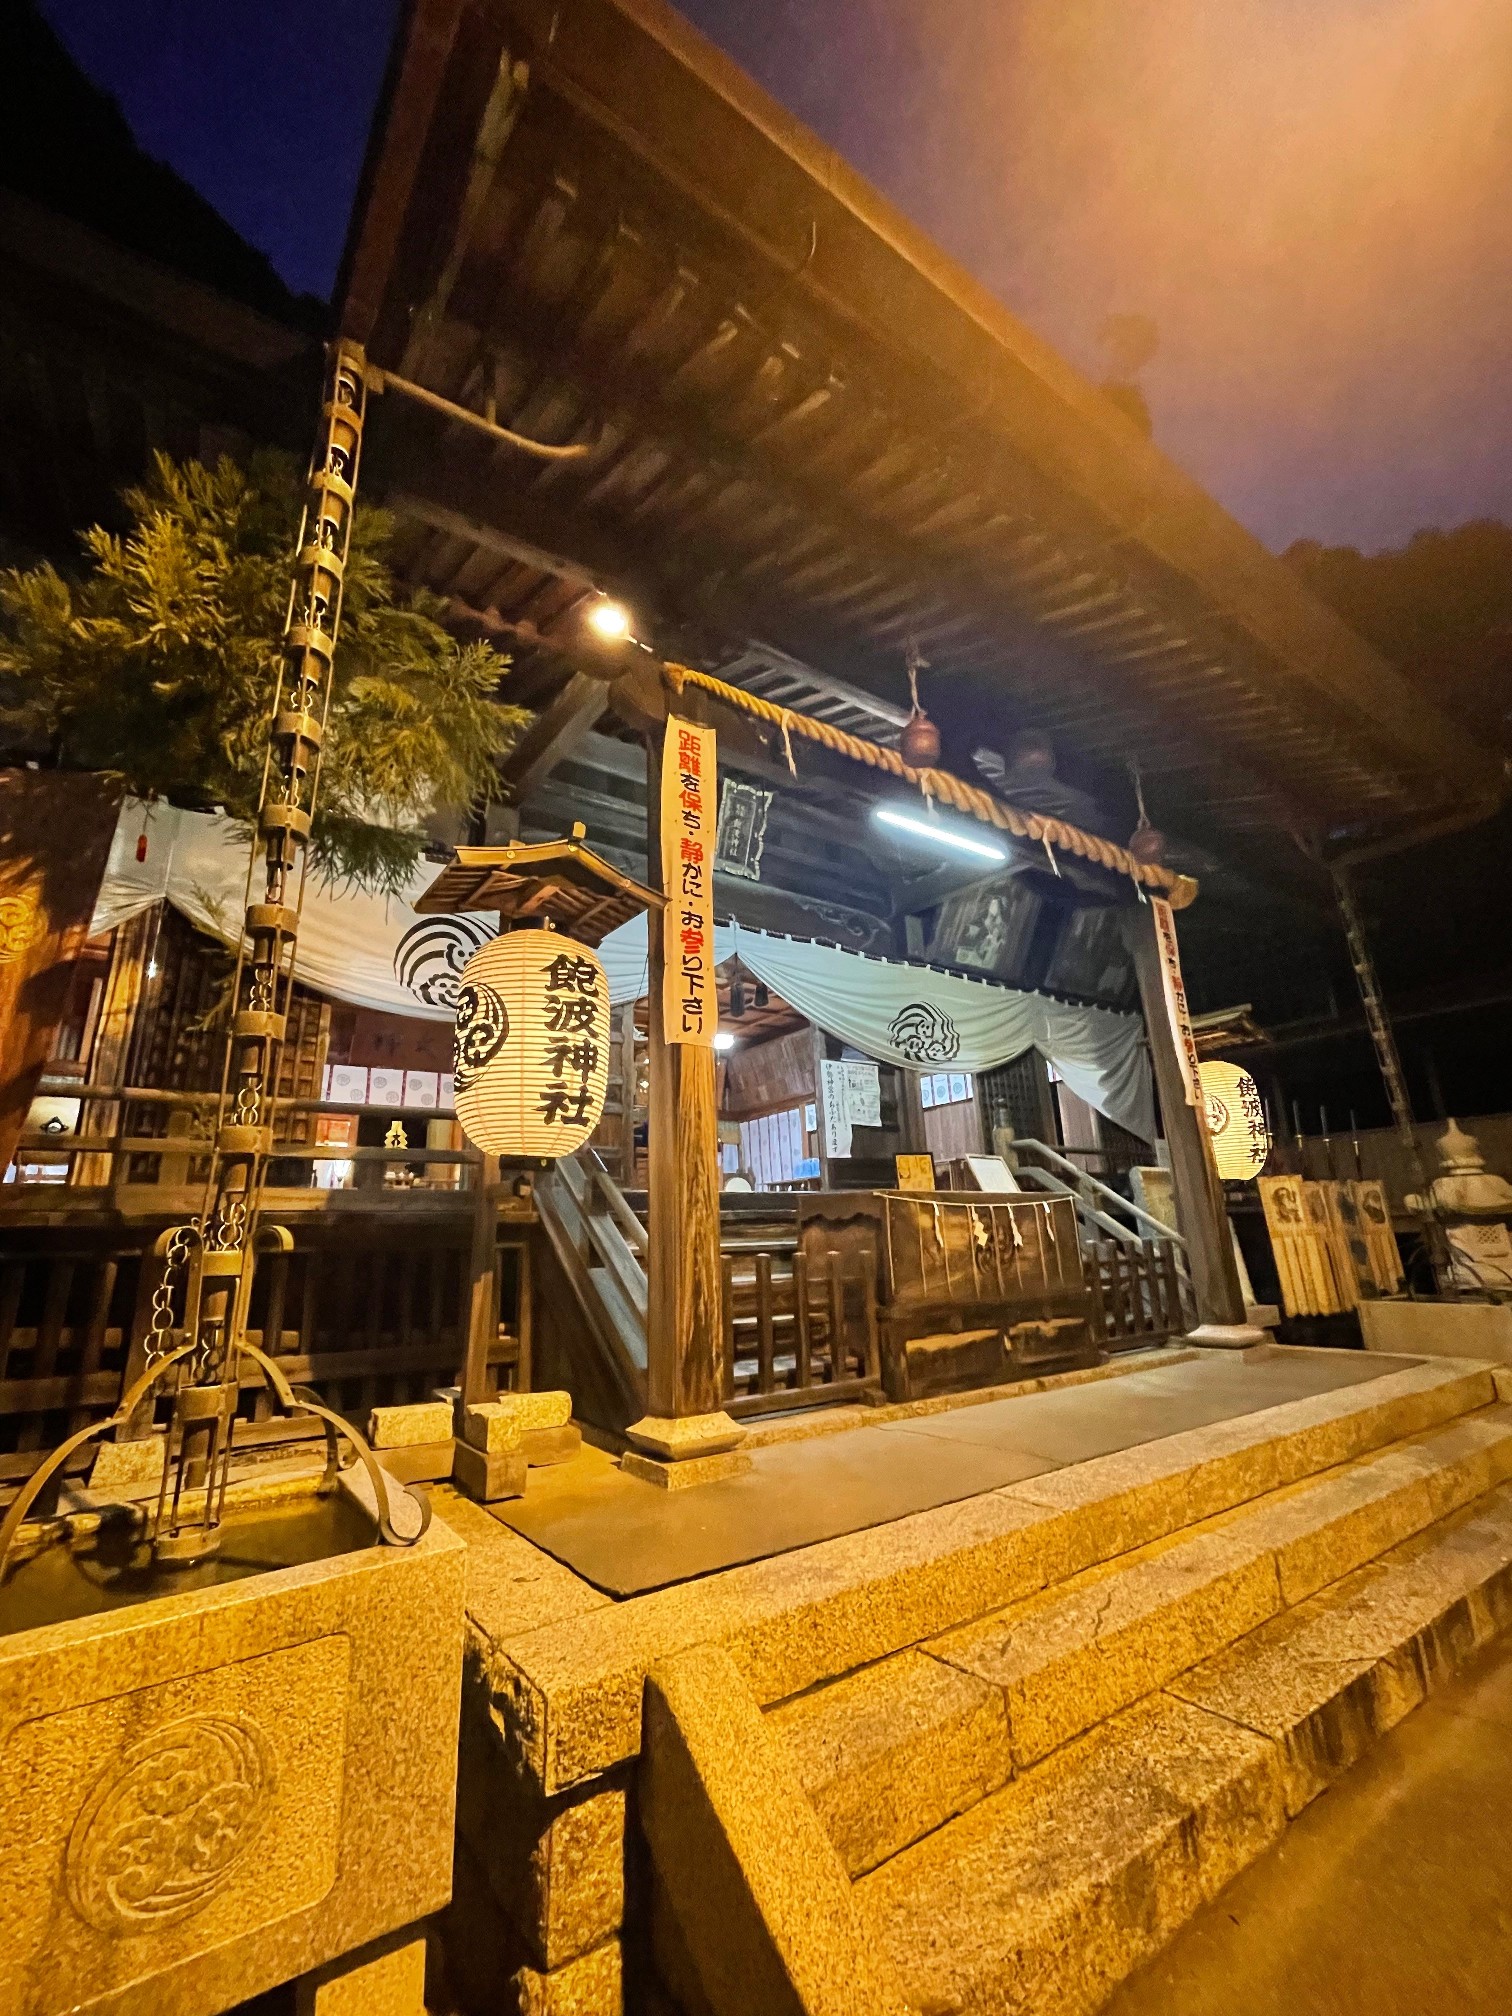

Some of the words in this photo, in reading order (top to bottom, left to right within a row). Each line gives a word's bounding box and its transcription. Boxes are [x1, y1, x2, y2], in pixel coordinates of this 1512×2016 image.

[678, 729, 705, 1035] 距離を保ち・静かに・お参り下さい
[532, 953, 600, 1127] 飽波神社
